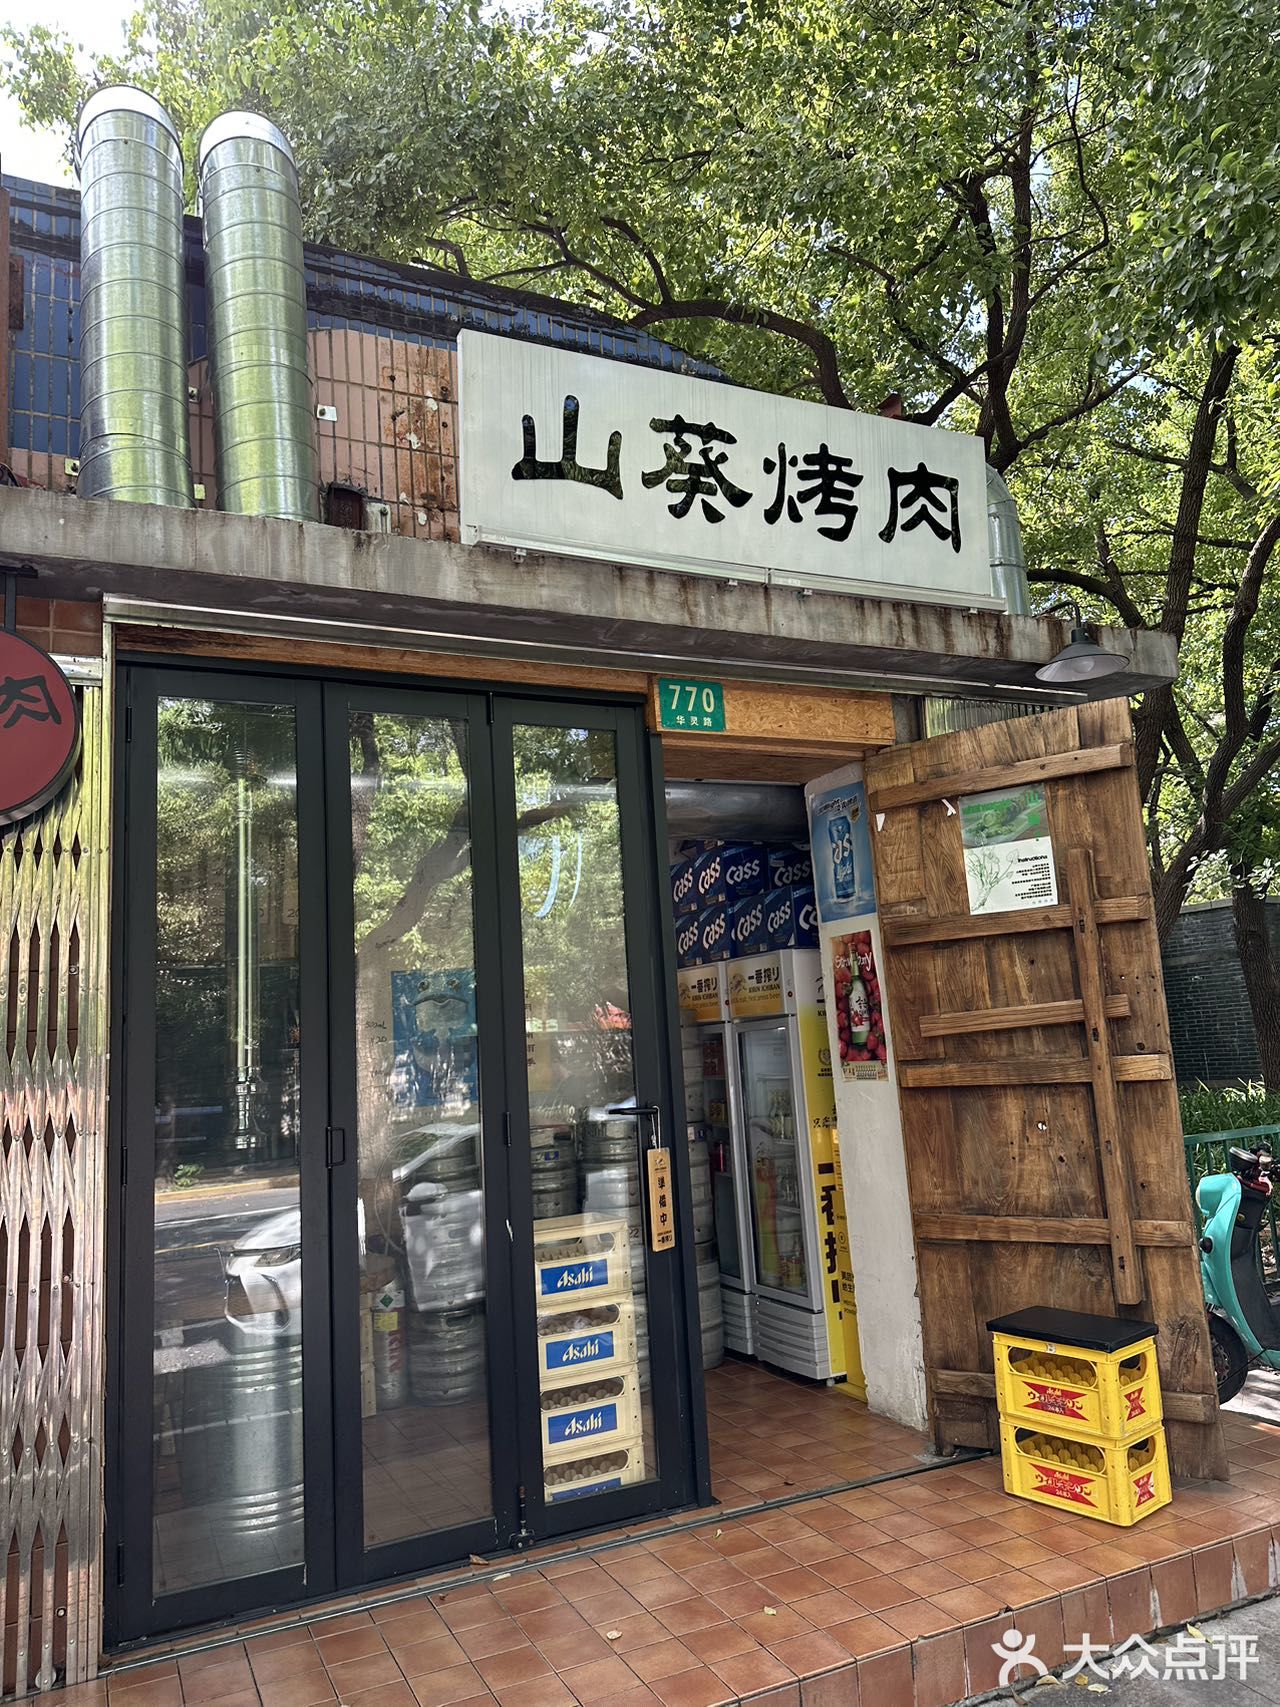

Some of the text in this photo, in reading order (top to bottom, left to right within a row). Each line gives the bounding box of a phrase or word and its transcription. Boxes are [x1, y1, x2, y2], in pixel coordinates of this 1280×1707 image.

[511, 394, 962, 554] 山葵烤肉
[668, 684, 715, 713] 770
[676, 715, 712, 727] 华灵路
[673, 867, 693, 902] Cass
[698, 856, 721, 894] Cass
[726, 859, 760, 885] Cass
[774, 860, 810, 887] Cass
[702, 912, 726, 949] Cass
[736, 903, 763, 942] Cass
[767, 901, 791, 933] Cass
[678, 921, 699, 955] Cass
[748, 966, 780, 984] 一番搾り
[557, 1265, 593, 1289] Asahi
[562, 1338, 599, 1362] Asahi
[564, 1411, 602, 1436] Asahi
